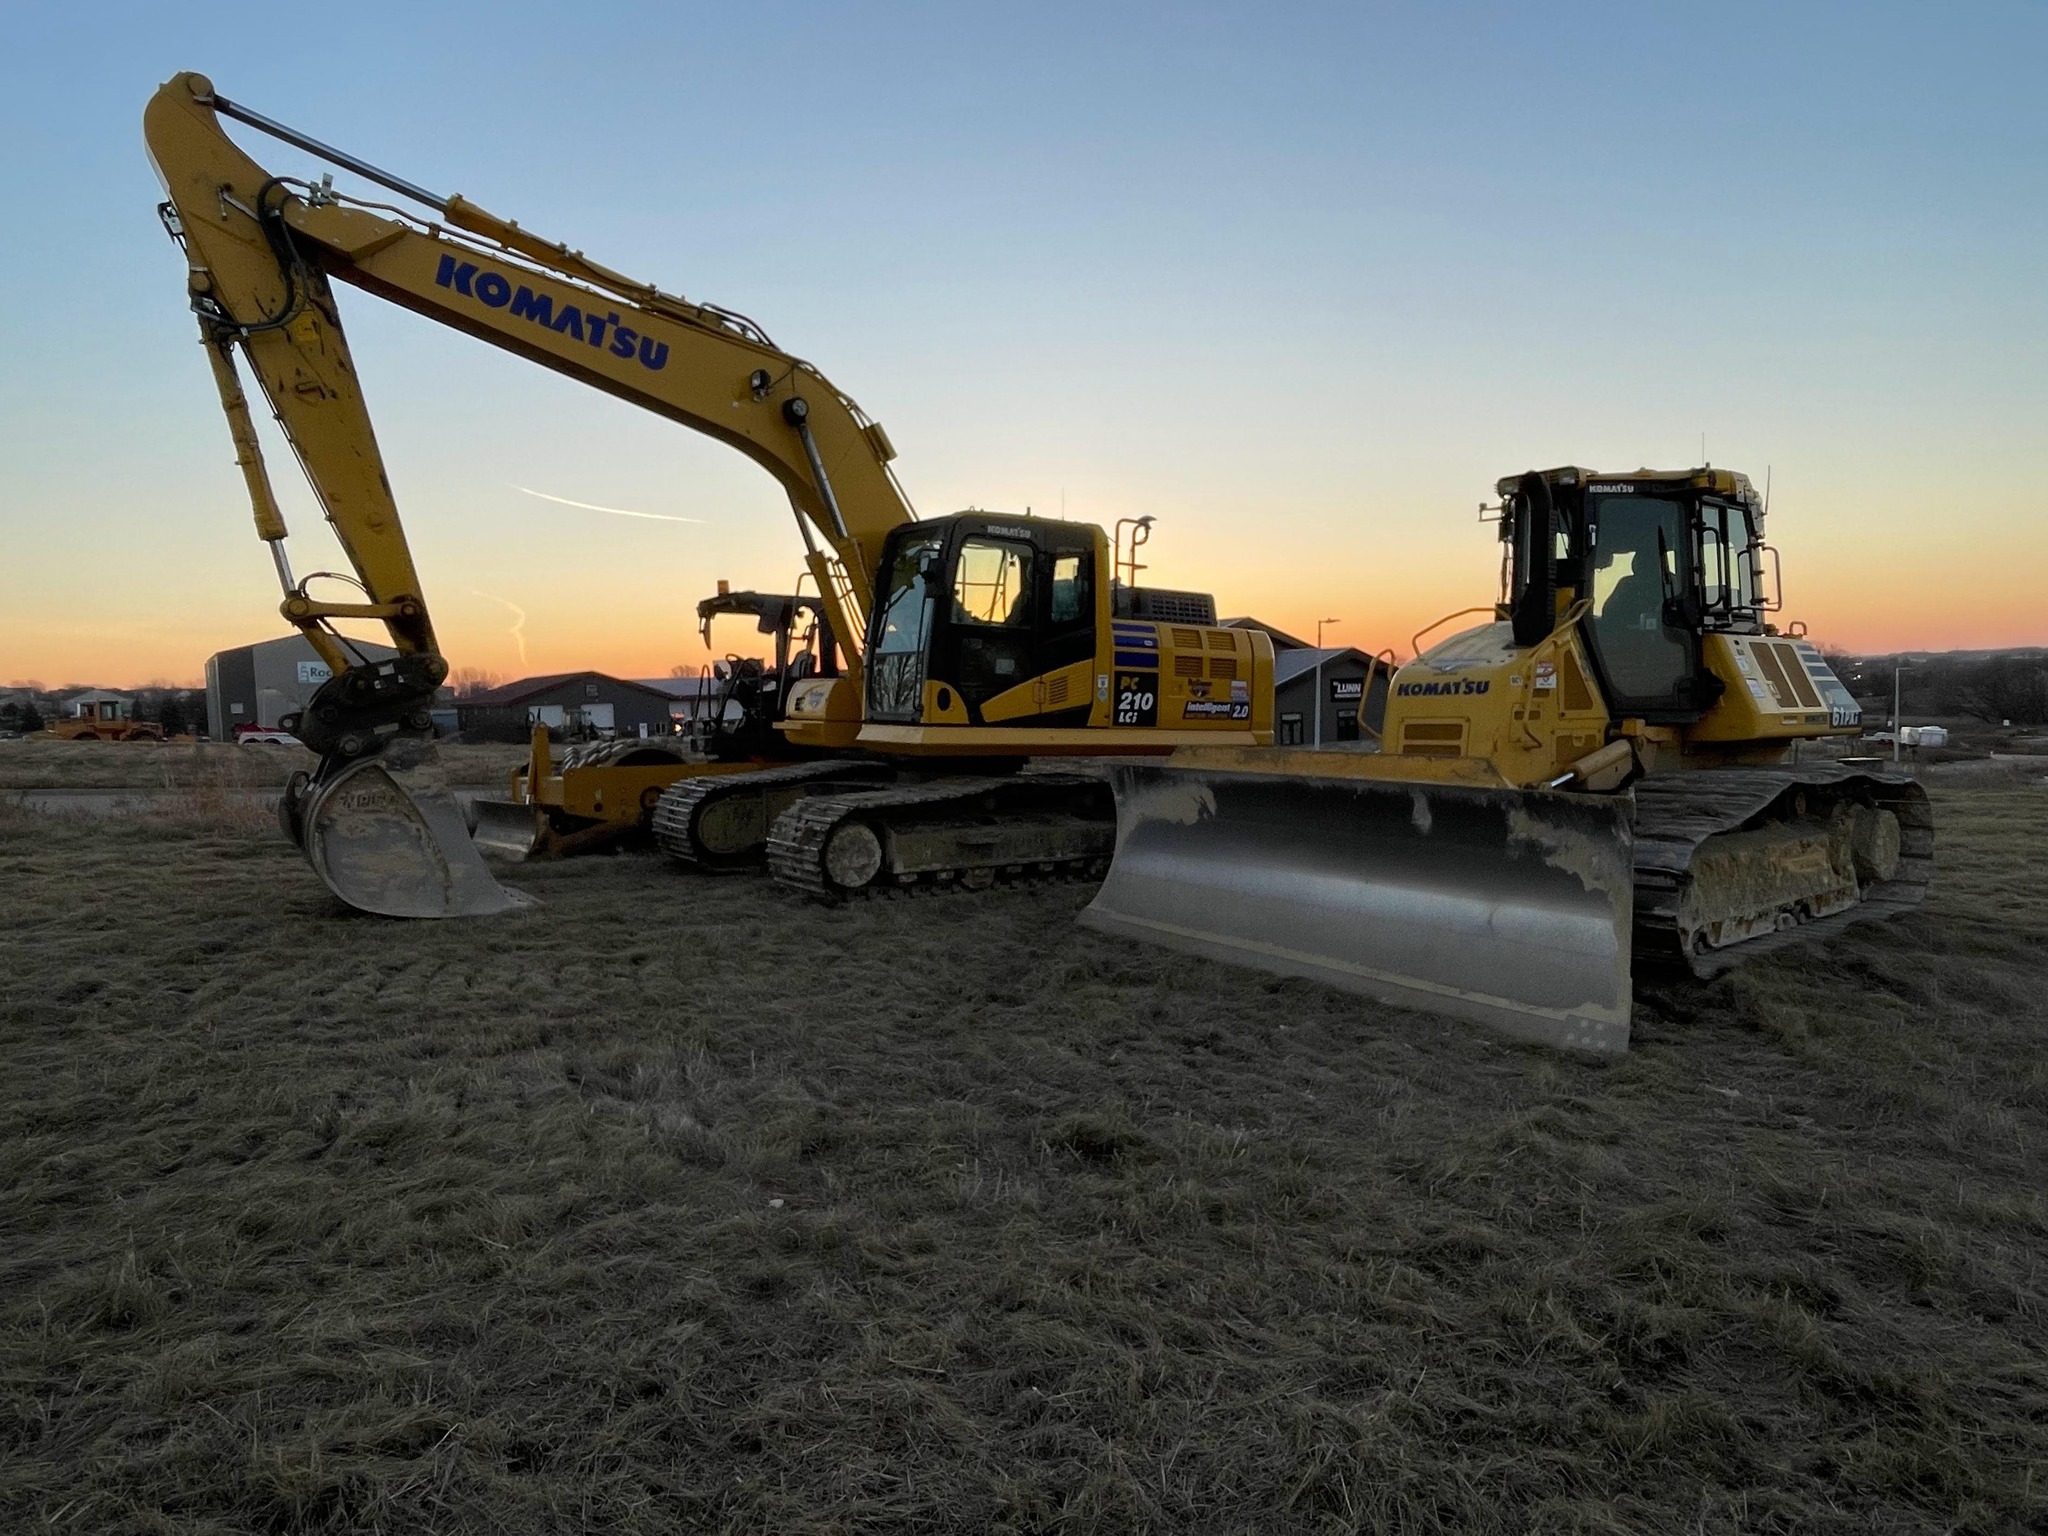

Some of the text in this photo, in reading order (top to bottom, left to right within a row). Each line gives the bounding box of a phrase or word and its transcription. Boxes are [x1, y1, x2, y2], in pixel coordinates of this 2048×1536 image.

[435, 253, 669, 371] KOMATSU
[1589, 484, 1634, 493] KOMATSU
[987, 525, 1031, 539] KOMATSU
[1119, 676, 1139, 690] PC
[1397, 677, 1490, 696] KOMATSU
[1118, 692, 1154, 711] 210
[1232, 705, 1249, 718] 2.0
